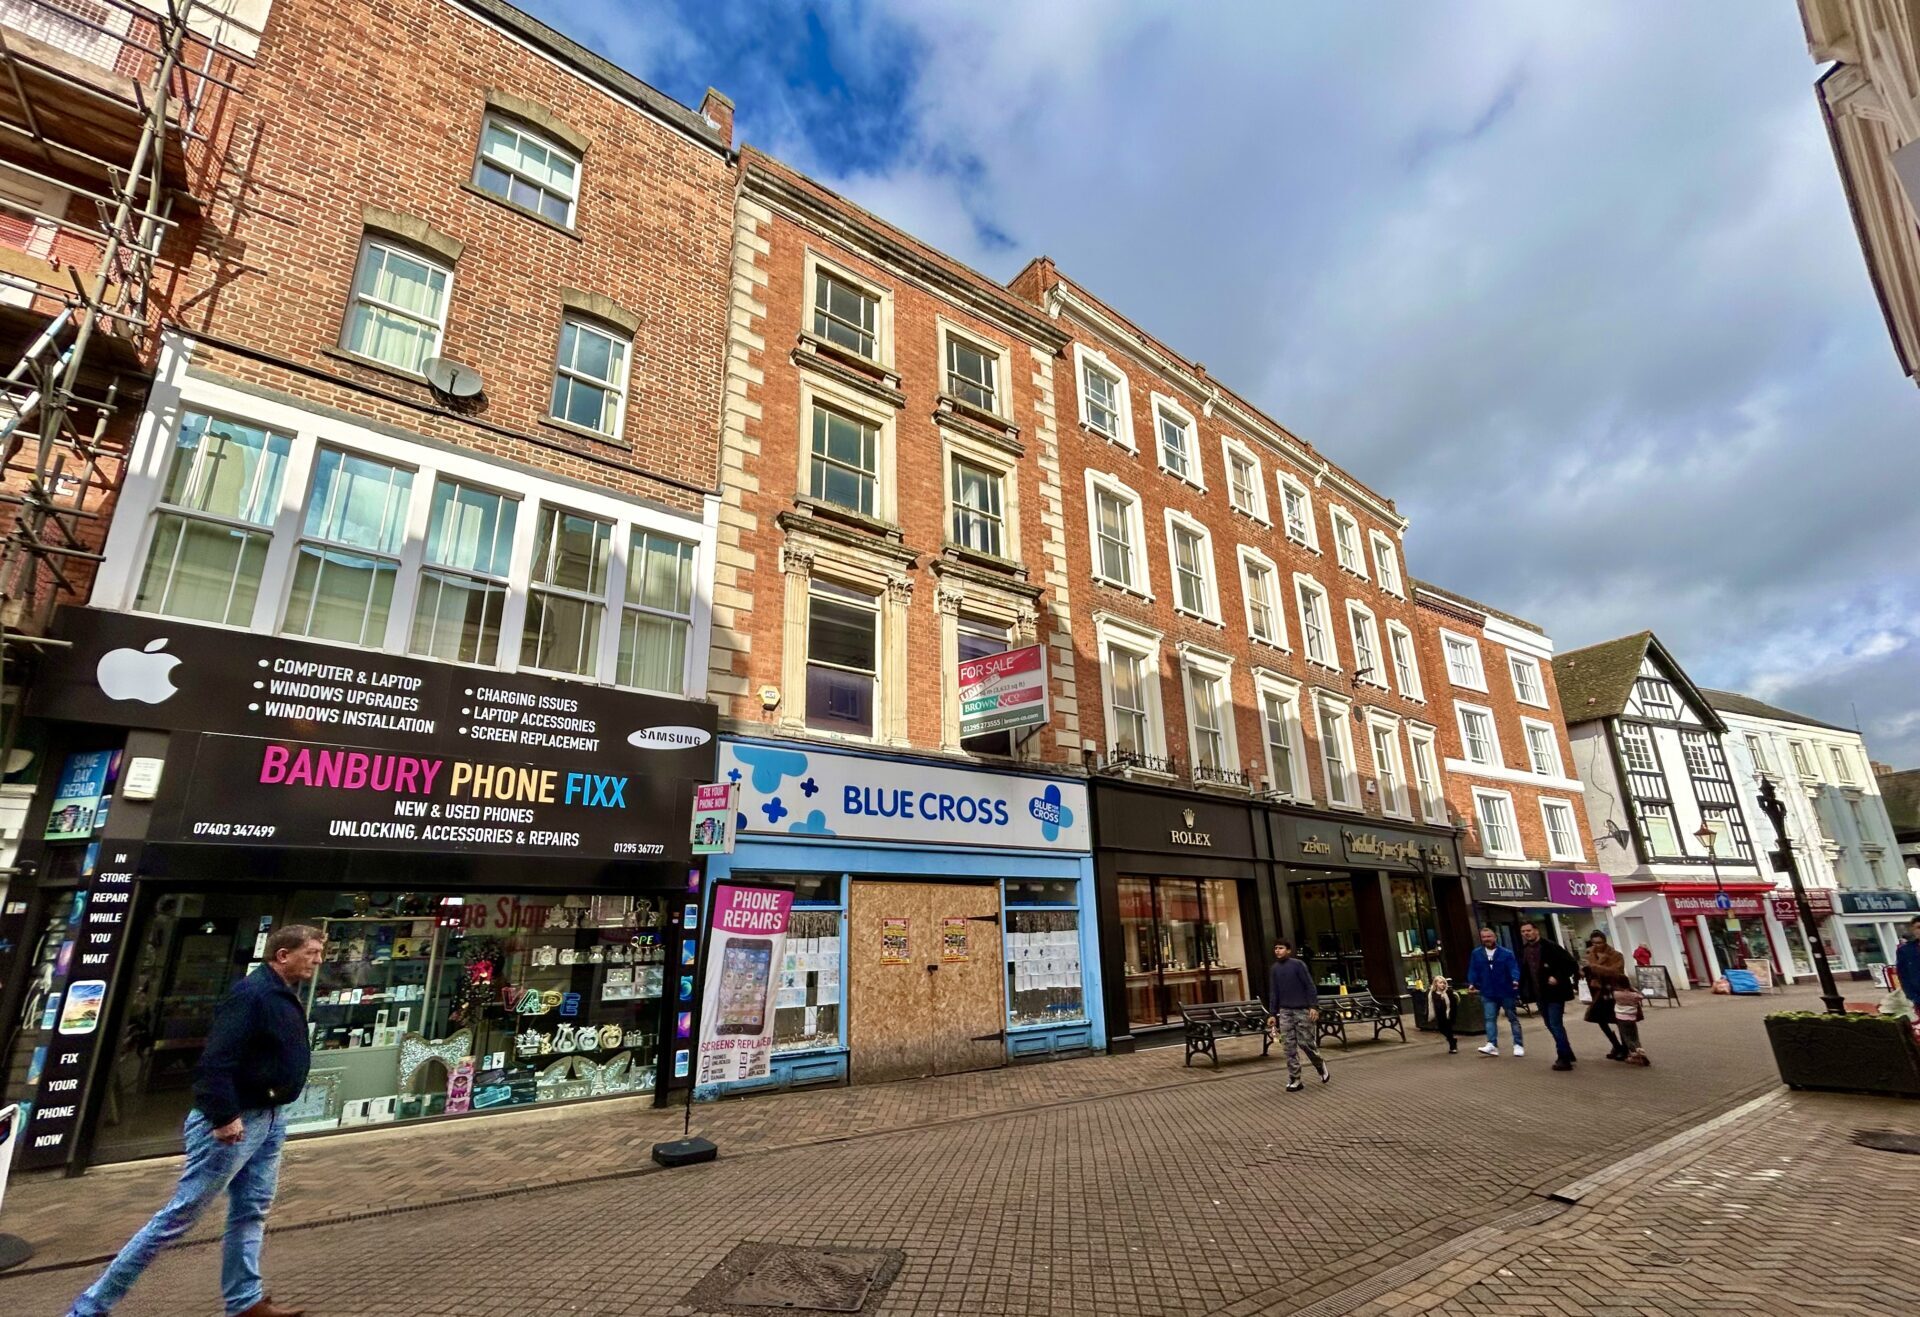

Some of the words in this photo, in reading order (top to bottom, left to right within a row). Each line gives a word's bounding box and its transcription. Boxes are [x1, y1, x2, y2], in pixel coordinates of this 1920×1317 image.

[273, 658, 353, 682] COMPUTER
[357, 671, 367, 684] &
[371, 672, 422, 691] LAPTOP
[961, 664, 984, 680] FOR
[986, 657, 1014, 674] SALE
[270, 679, 343, 702] WINDOWS
[347, 690, 419, 711] UPGRADES
[476, 687, 535, 707] CHARGING
[538, 695, 578, 712] ISSUES
[964, 696, 996, 713] BROWN
[265, 701, 340, 723] WINDOWS
[342, 711, 435, 734] INSTALLATION
[473, 706, 518, 724] LAPTOP
[521, 715, 596, 733] ACCESSORIES
[470, 726, 517, 743] SCREEN
[520, 733, 600, 752] REPLACEMENT
[640, 729, 701, 746] SAMSUNG
[73, 754, 101, 768] SAME
[72, 768, 92, 783] DAY
[259, 745, 443, 794] BANBURY
[449, 762, 558, 804] PHONE
[564, 772, 628, 808] FIXX
[62, 782, 95, 797] REPAIR
[703, 787, 711, 797] FIX
[711, 785, 724, 796] YOUR
[699, 798, 714, 809] PHONE
[714, 797, 727, 807] NOW
[843, 785, 914, 818] BLUE
[919, 788, 1009, 826] CROSS
[1033, 798, 1052, 812] BLUE
[394, 800, 428, 817] NEW
[430, 804, 441, 818] &
[445, 804, 480, 820] USED
[483, 807, 534, 823] PHONES
[1033, 808, 1059, 823] CROSS
[193, 822, 231, 836] 07403
[232, 824, 275, 838] 347499
[329, 820, 419, 840] UNLOCKING,
[422, 824, 513, 844] ACCESSORIES
[516, 832, 526, 844] &
[528, 830, 580, 846] REPAIRS
[1171, 830, 1211, 847] ROLEX
[614, 842, 636, 853] 01295
[638, 844, 664, 854] 367727
[1302, 841, 1330, 854] ZENITH
[115, 853, 126, 863] IN
[99, 872, 132, 883] STORE
[1486, 872, 1531, 889] HEMEN
[1568, 879, 1599, 898] Scope
[92, 892, 128, 903] REPAIR
[732, 890, 781, 910] PHONE
[1675, 897, 1697, 908] British
[1698, 898, 1718, 908] Hear
[89, 913, 122, 923] WHILE
[723, 909, 782, 930] REPAIRS
[89, 932, 111, 943] YOU
[82, 953, 108, 964] WAIT
[501, 987, 581, 1015] VAPE
[701, 1040, 735, 1053] SCREENS
[737, 1037, 771, 1049] REPLACED
[60, 1053, 79, 1064] FIX
[48, 1079, 78, 1091] YOUR
[36, 1105, 75, 1119] PHONE
[34, 1133, 63, 1147] NOW
